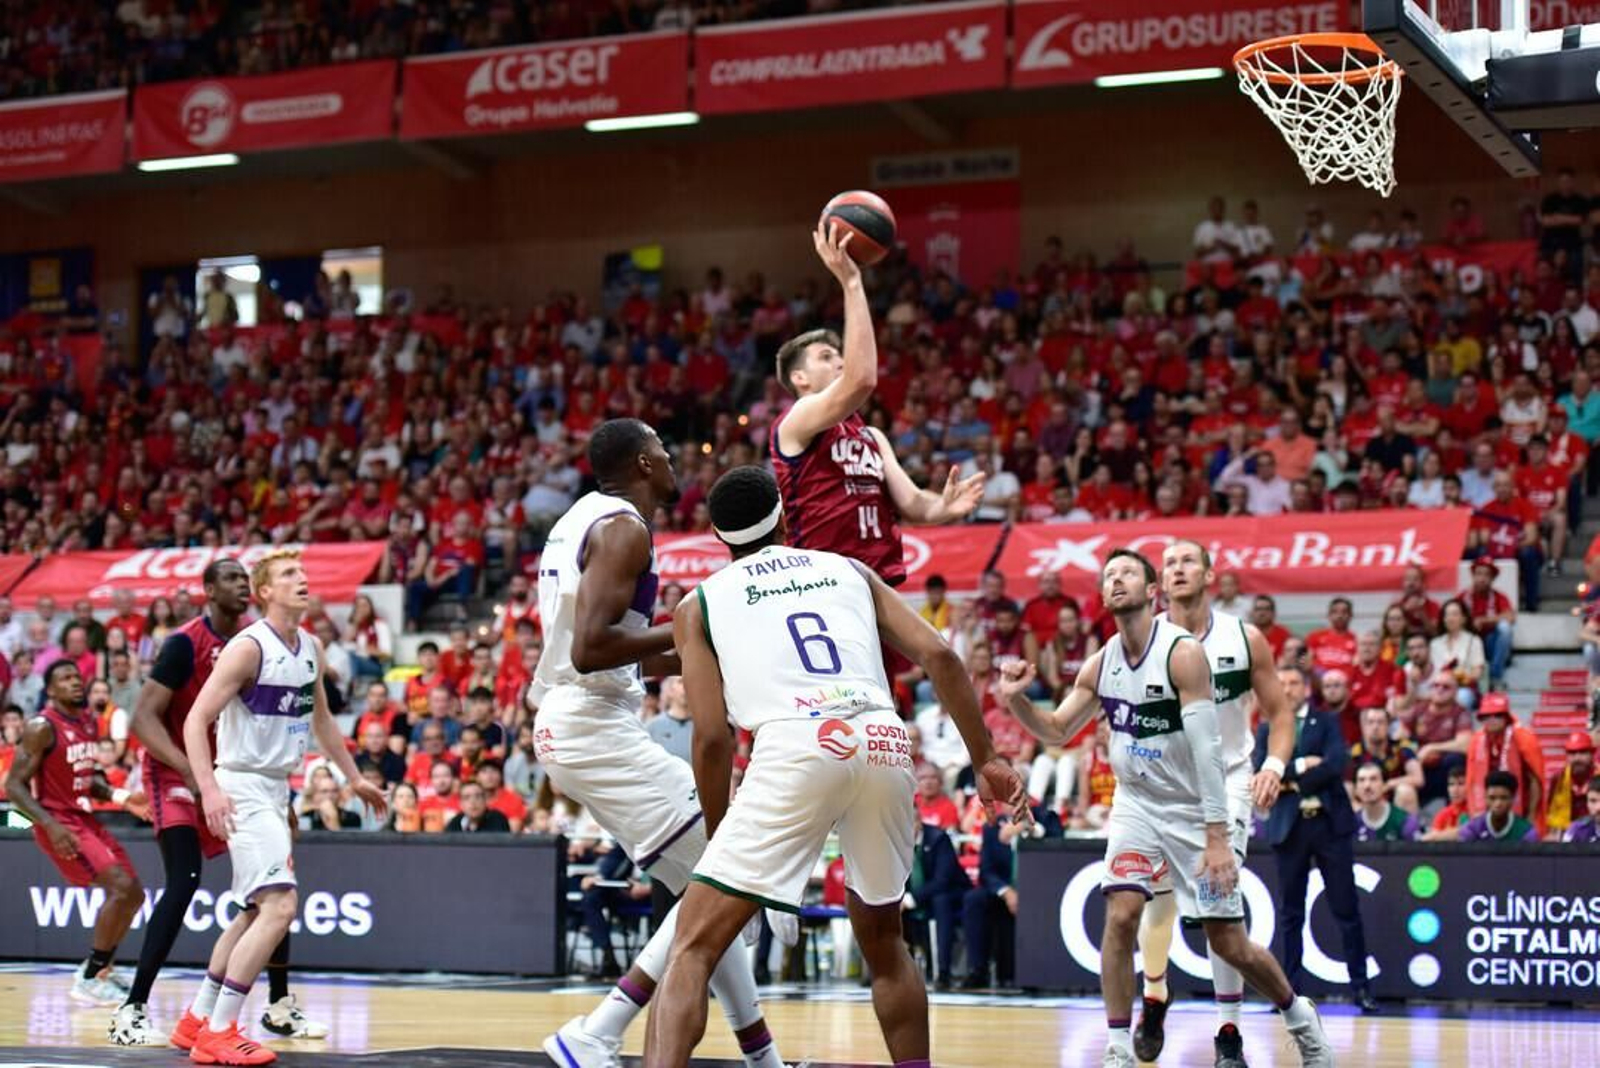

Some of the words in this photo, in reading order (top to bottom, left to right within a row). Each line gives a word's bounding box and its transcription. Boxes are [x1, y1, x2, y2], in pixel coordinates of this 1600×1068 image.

[1071, 3, 1338, 56] GRUPOSURESTE
[495, 45, 620, 93] caser
[858, 505, 882, 539] 14
[742, 555, 813, 576] TAYLOR
[786, 612, 842, 674] 6
[867, 739, 894, 753] DEL
[895, 742, 911, 757] SO
[1466, 890, 1600, 923] CLÍNICAS
[1466, 926, 1600, 954] OFTALM
[1466, 957, 1600, 987] CENTRO
